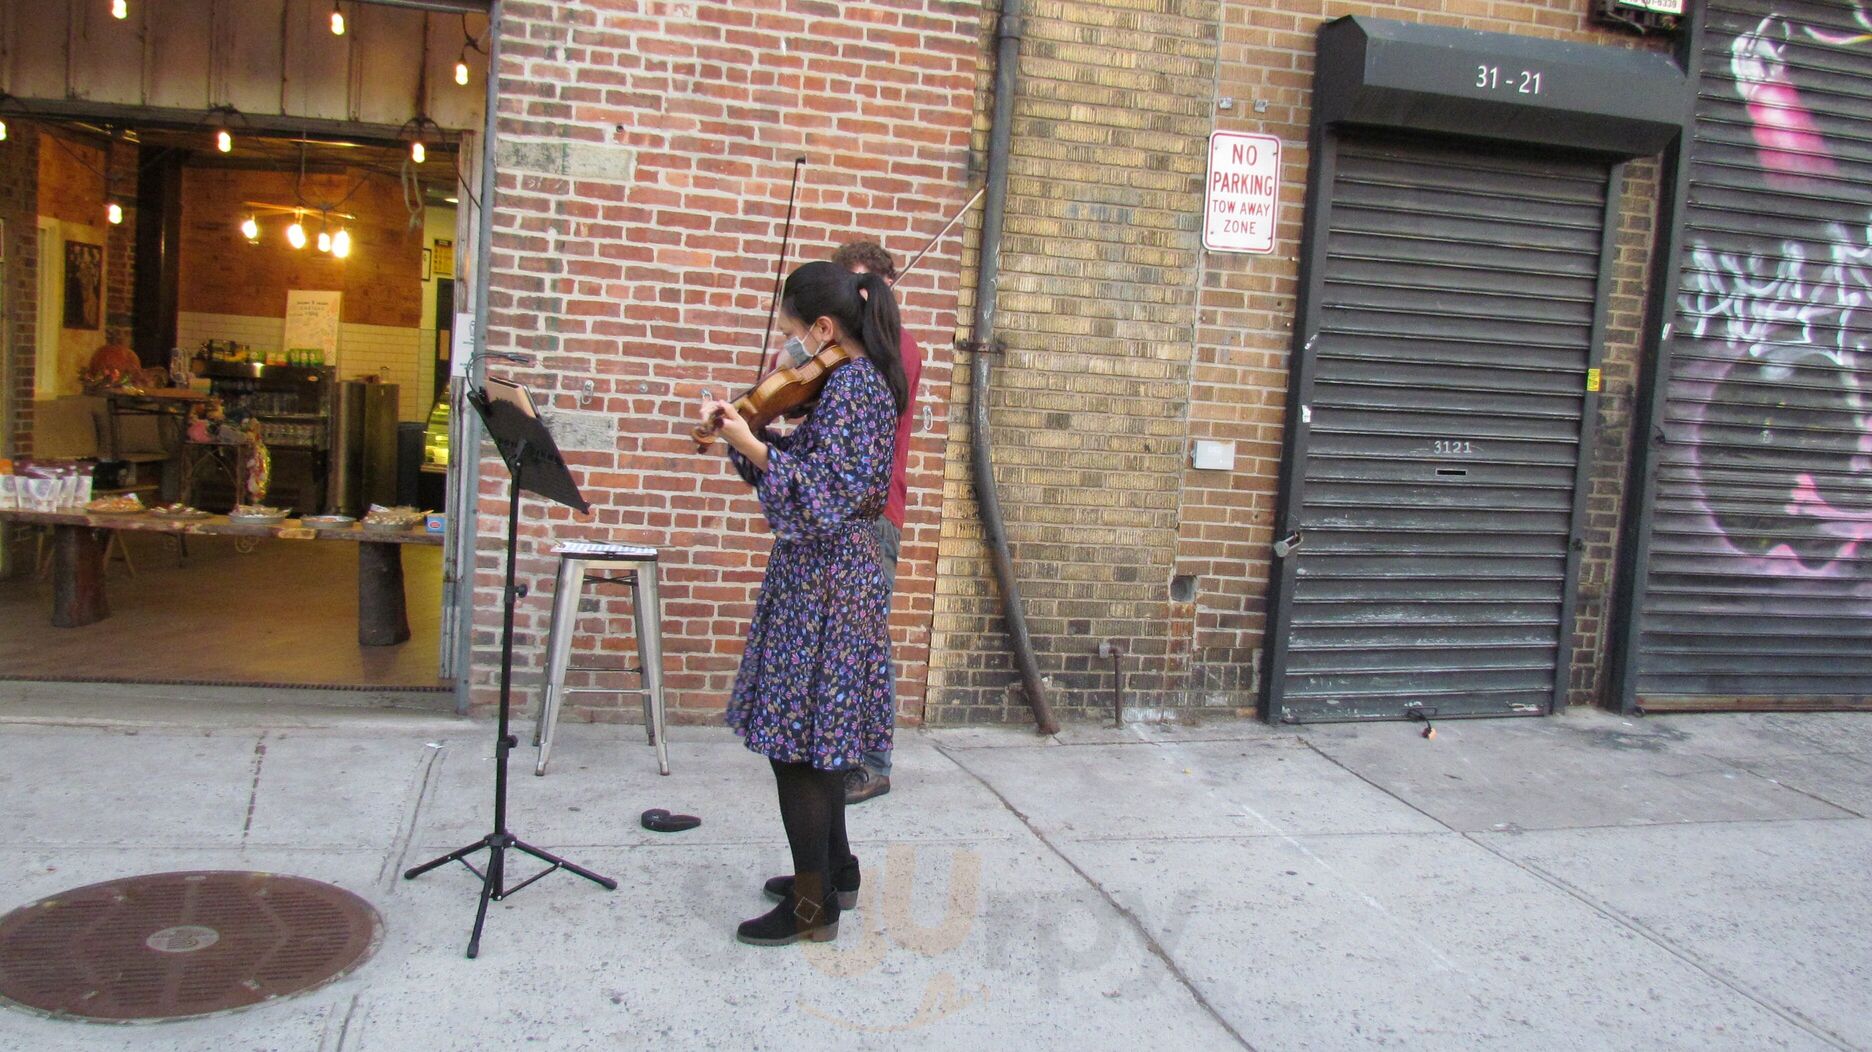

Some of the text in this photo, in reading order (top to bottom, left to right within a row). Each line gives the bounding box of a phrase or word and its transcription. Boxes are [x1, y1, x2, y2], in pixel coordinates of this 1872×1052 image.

[1232, 144, 1257, 166] NO
[1213, 171, 1272, 196] PARKING
[1213, 200, 1270, 216] TOW AWAY
[1223, 219, 1256, 235] ZONE
[1434, 440, 1472, 454] 3121
